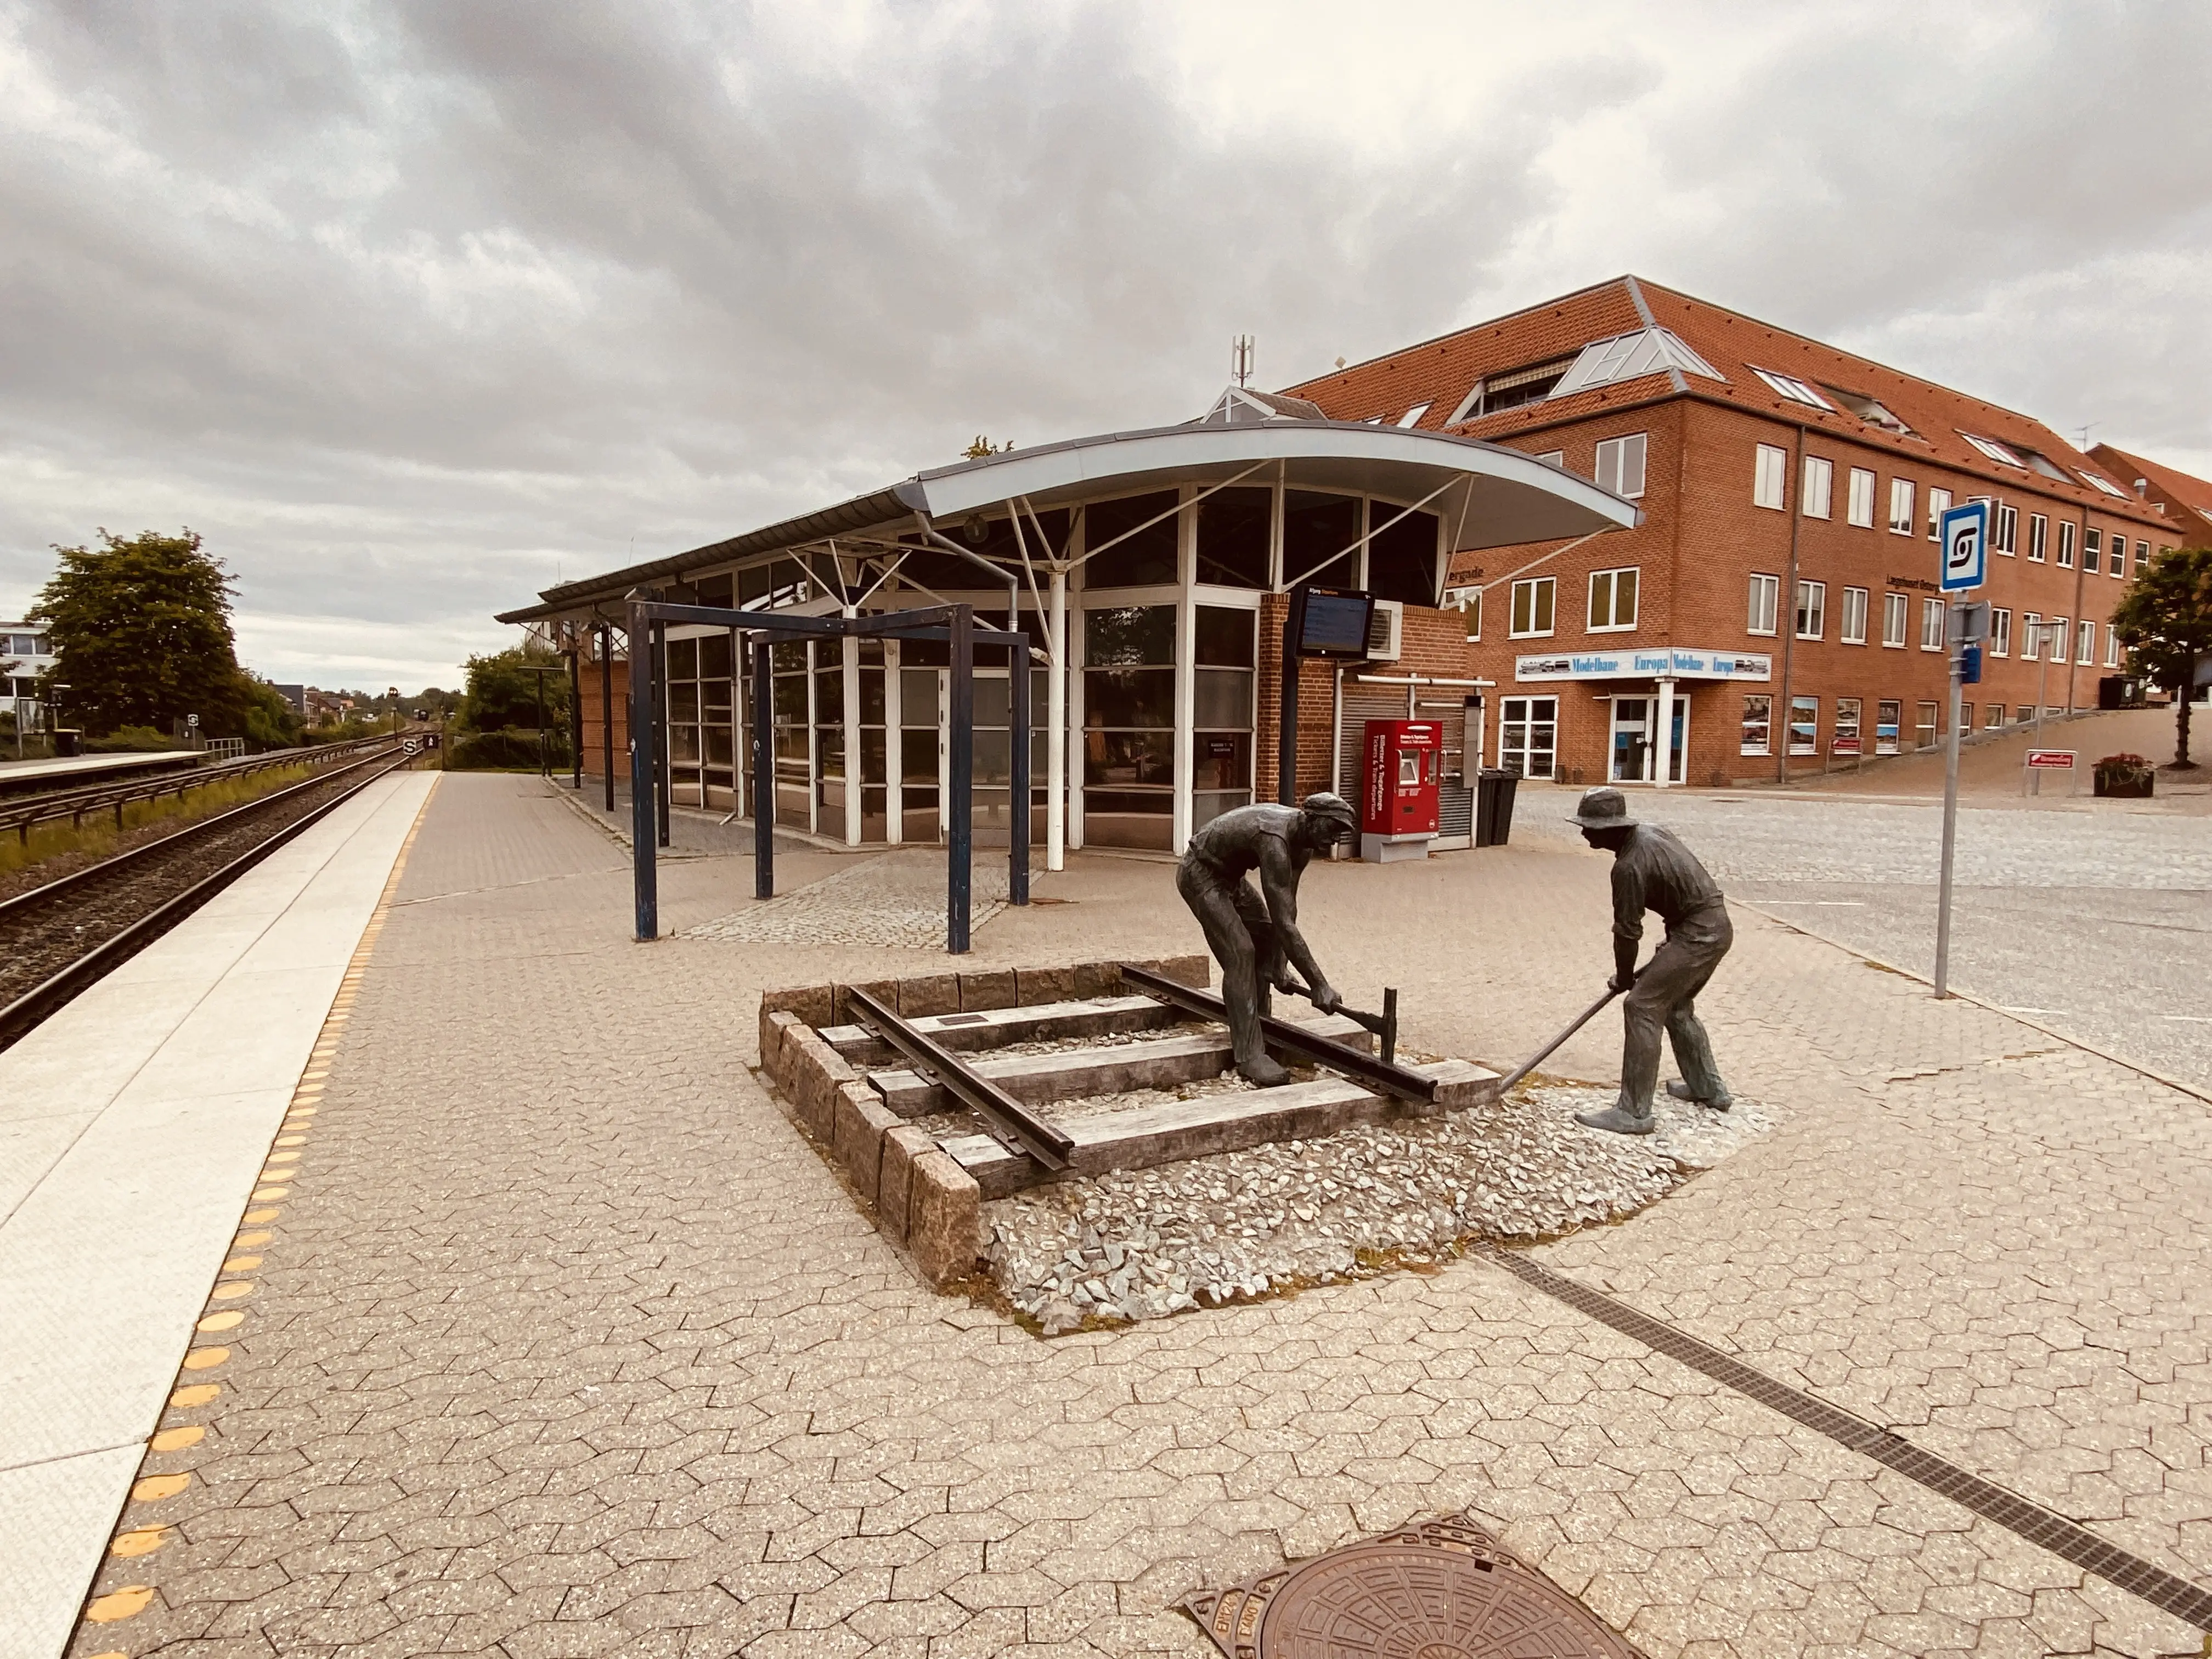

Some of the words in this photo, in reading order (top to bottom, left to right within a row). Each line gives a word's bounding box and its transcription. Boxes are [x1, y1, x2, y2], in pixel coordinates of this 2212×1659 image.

[1449, 566, 1483, 583] ergade
[1573, 657, 1618, 672] Modelbane
[1634, 655, 1668, 674] Europa
[1673, 653, 1703, 670] Modelbane
[1713, 657, 1734, 676] Europa
[404, 741, 415, 753] S
